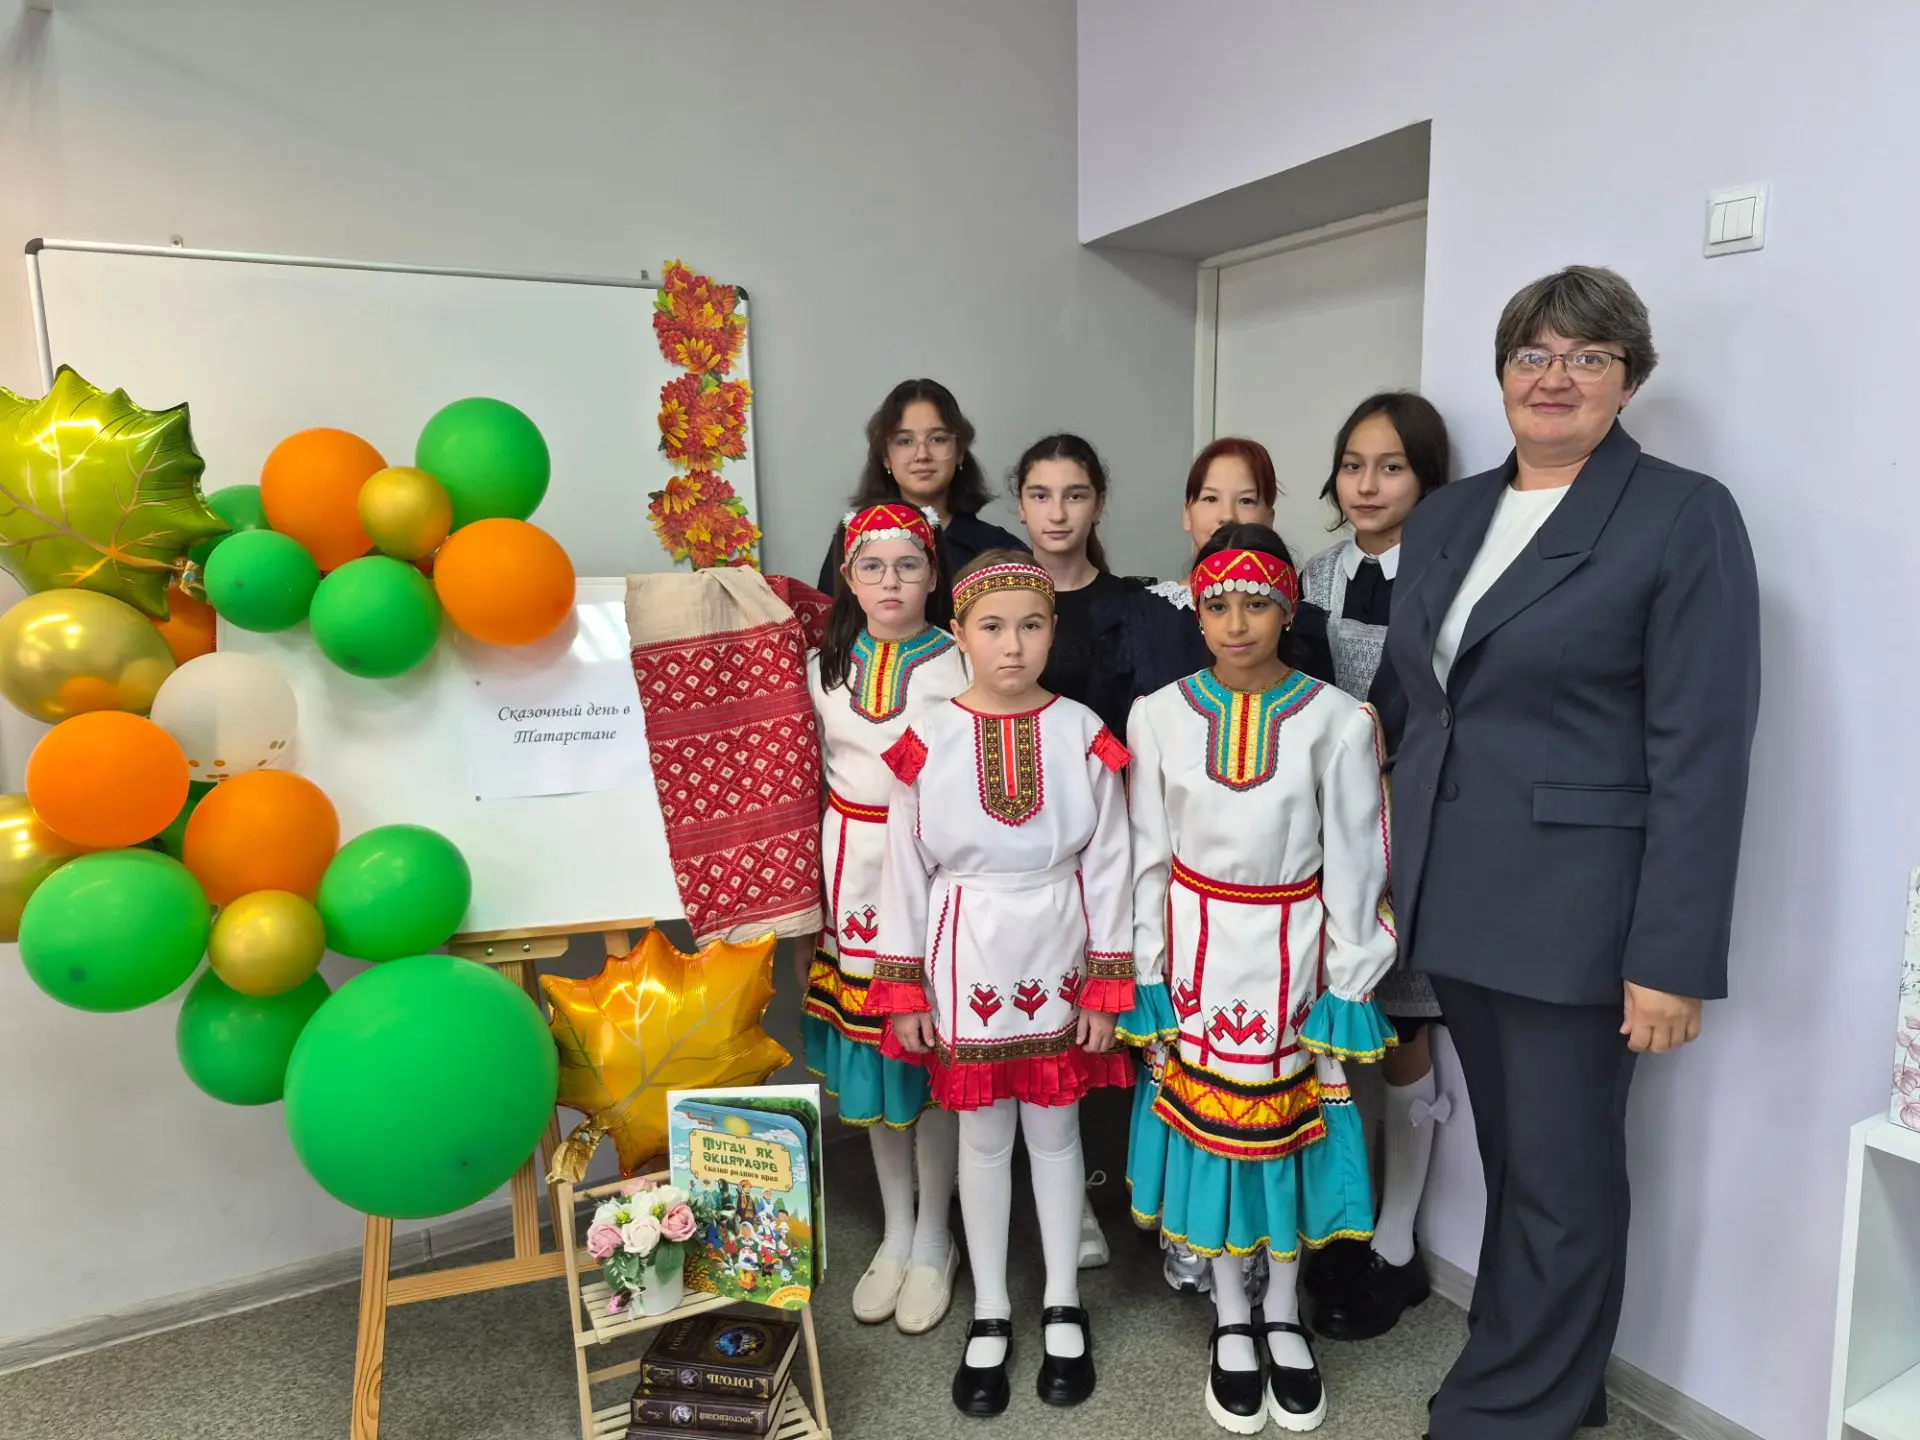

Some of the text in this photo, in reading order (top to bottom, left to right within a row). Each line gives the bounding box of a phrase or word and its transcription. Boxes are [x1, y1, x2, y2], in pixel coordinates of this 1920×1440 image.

[498, 701, 631, 722] Сказочный день в
[513, 728, 617, 746] Татарстане
[706, 1373, 754, 1389] ГОГОЛЬ
